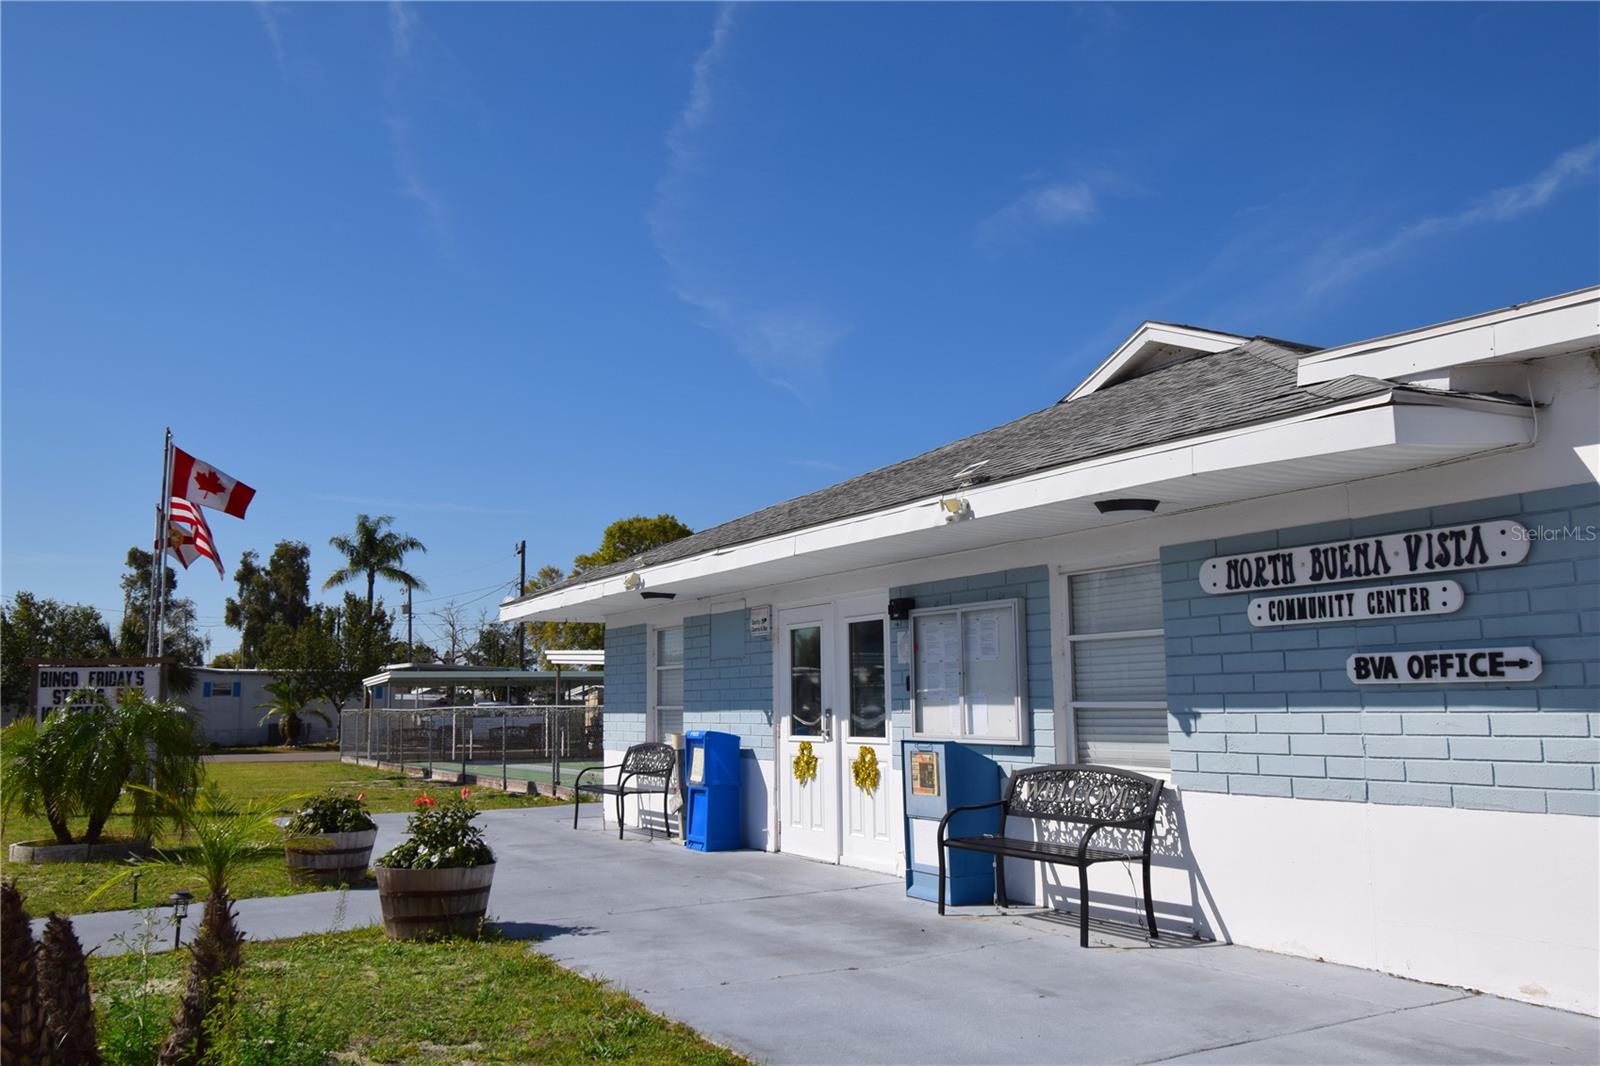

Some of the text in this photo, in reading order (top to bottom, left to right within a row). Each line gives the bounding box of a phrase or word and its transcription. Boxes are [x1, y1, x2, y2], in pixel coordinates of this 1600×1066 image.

[1225, 525, 1489, 590] NORTH BUENA VISTA
[1268, 587, 1430, 622] COMMUNITY CENTER
[40, 670, 144, 688] BINGO FRIDAY'S
[1354, 652, 1505, 680] BVA OFFICE
